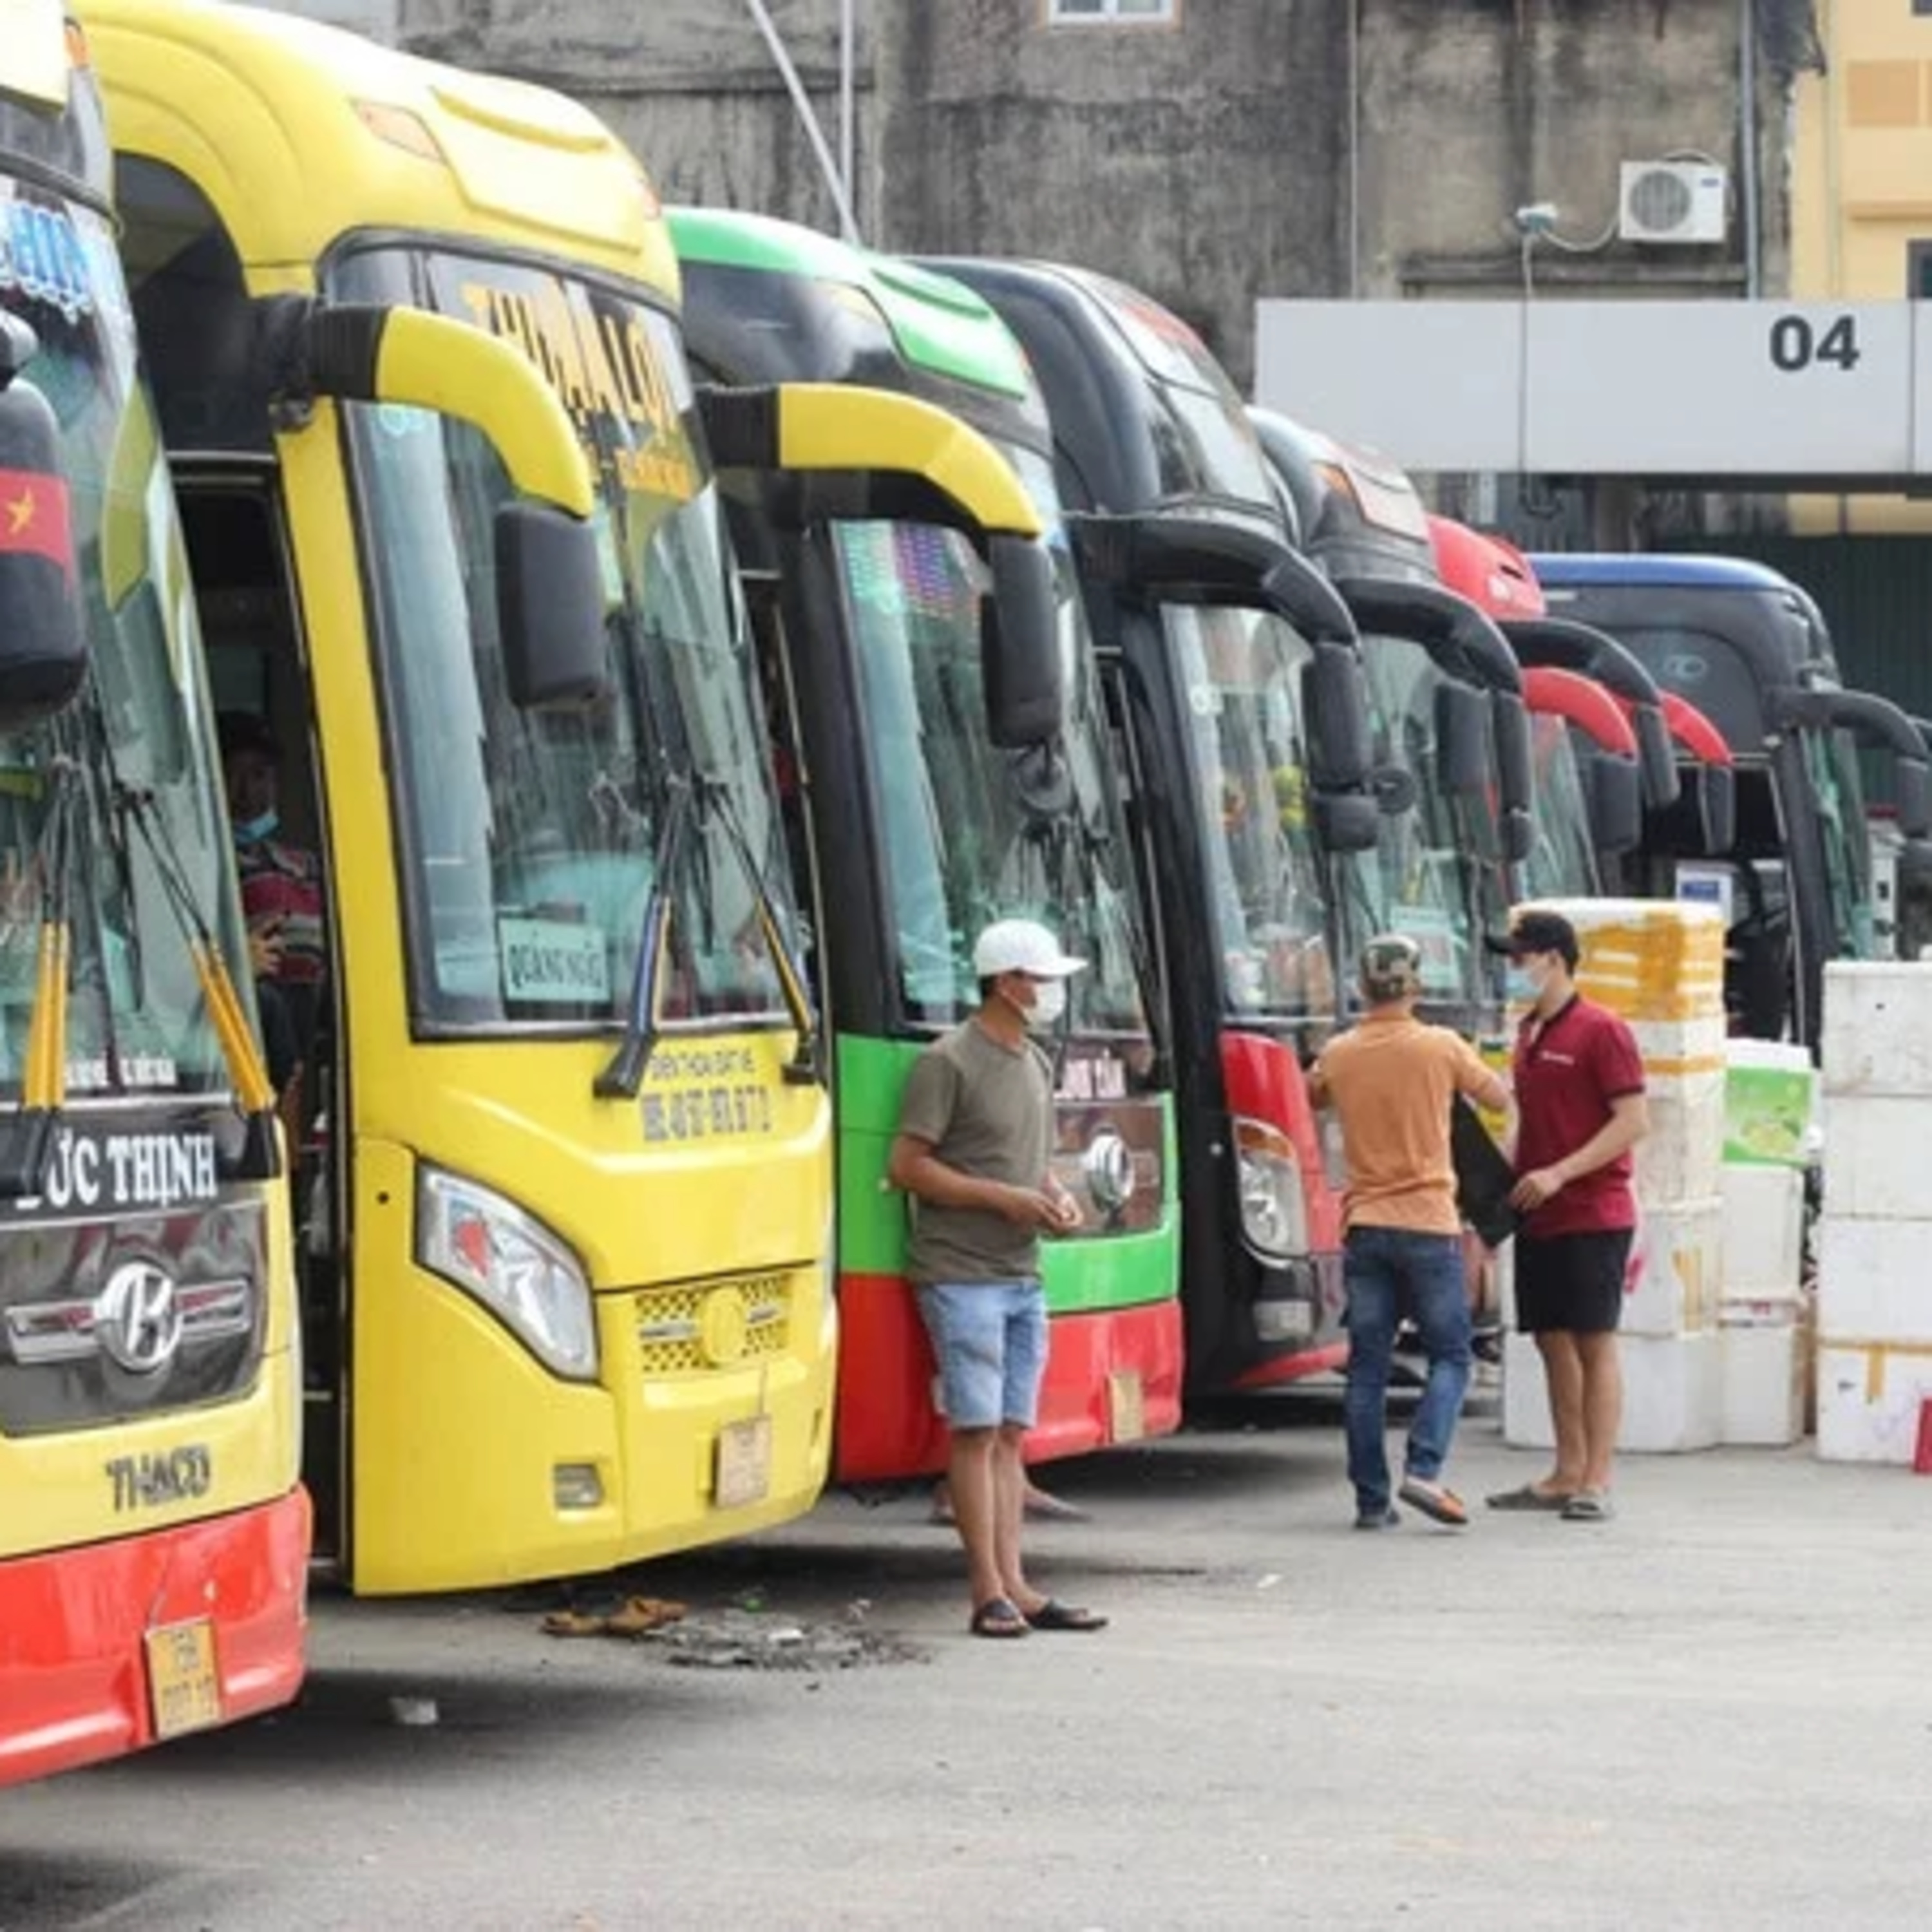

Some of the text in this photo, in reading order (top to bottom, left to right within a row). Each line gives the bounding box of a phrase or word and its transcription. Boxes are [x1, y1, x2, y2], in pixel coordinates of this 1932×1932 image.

[1770, 316, 1860, 372] 04
[15, 1125, 218, 1210] ỨC THỊNH
[106, 1444, 210, 1512] THACO
